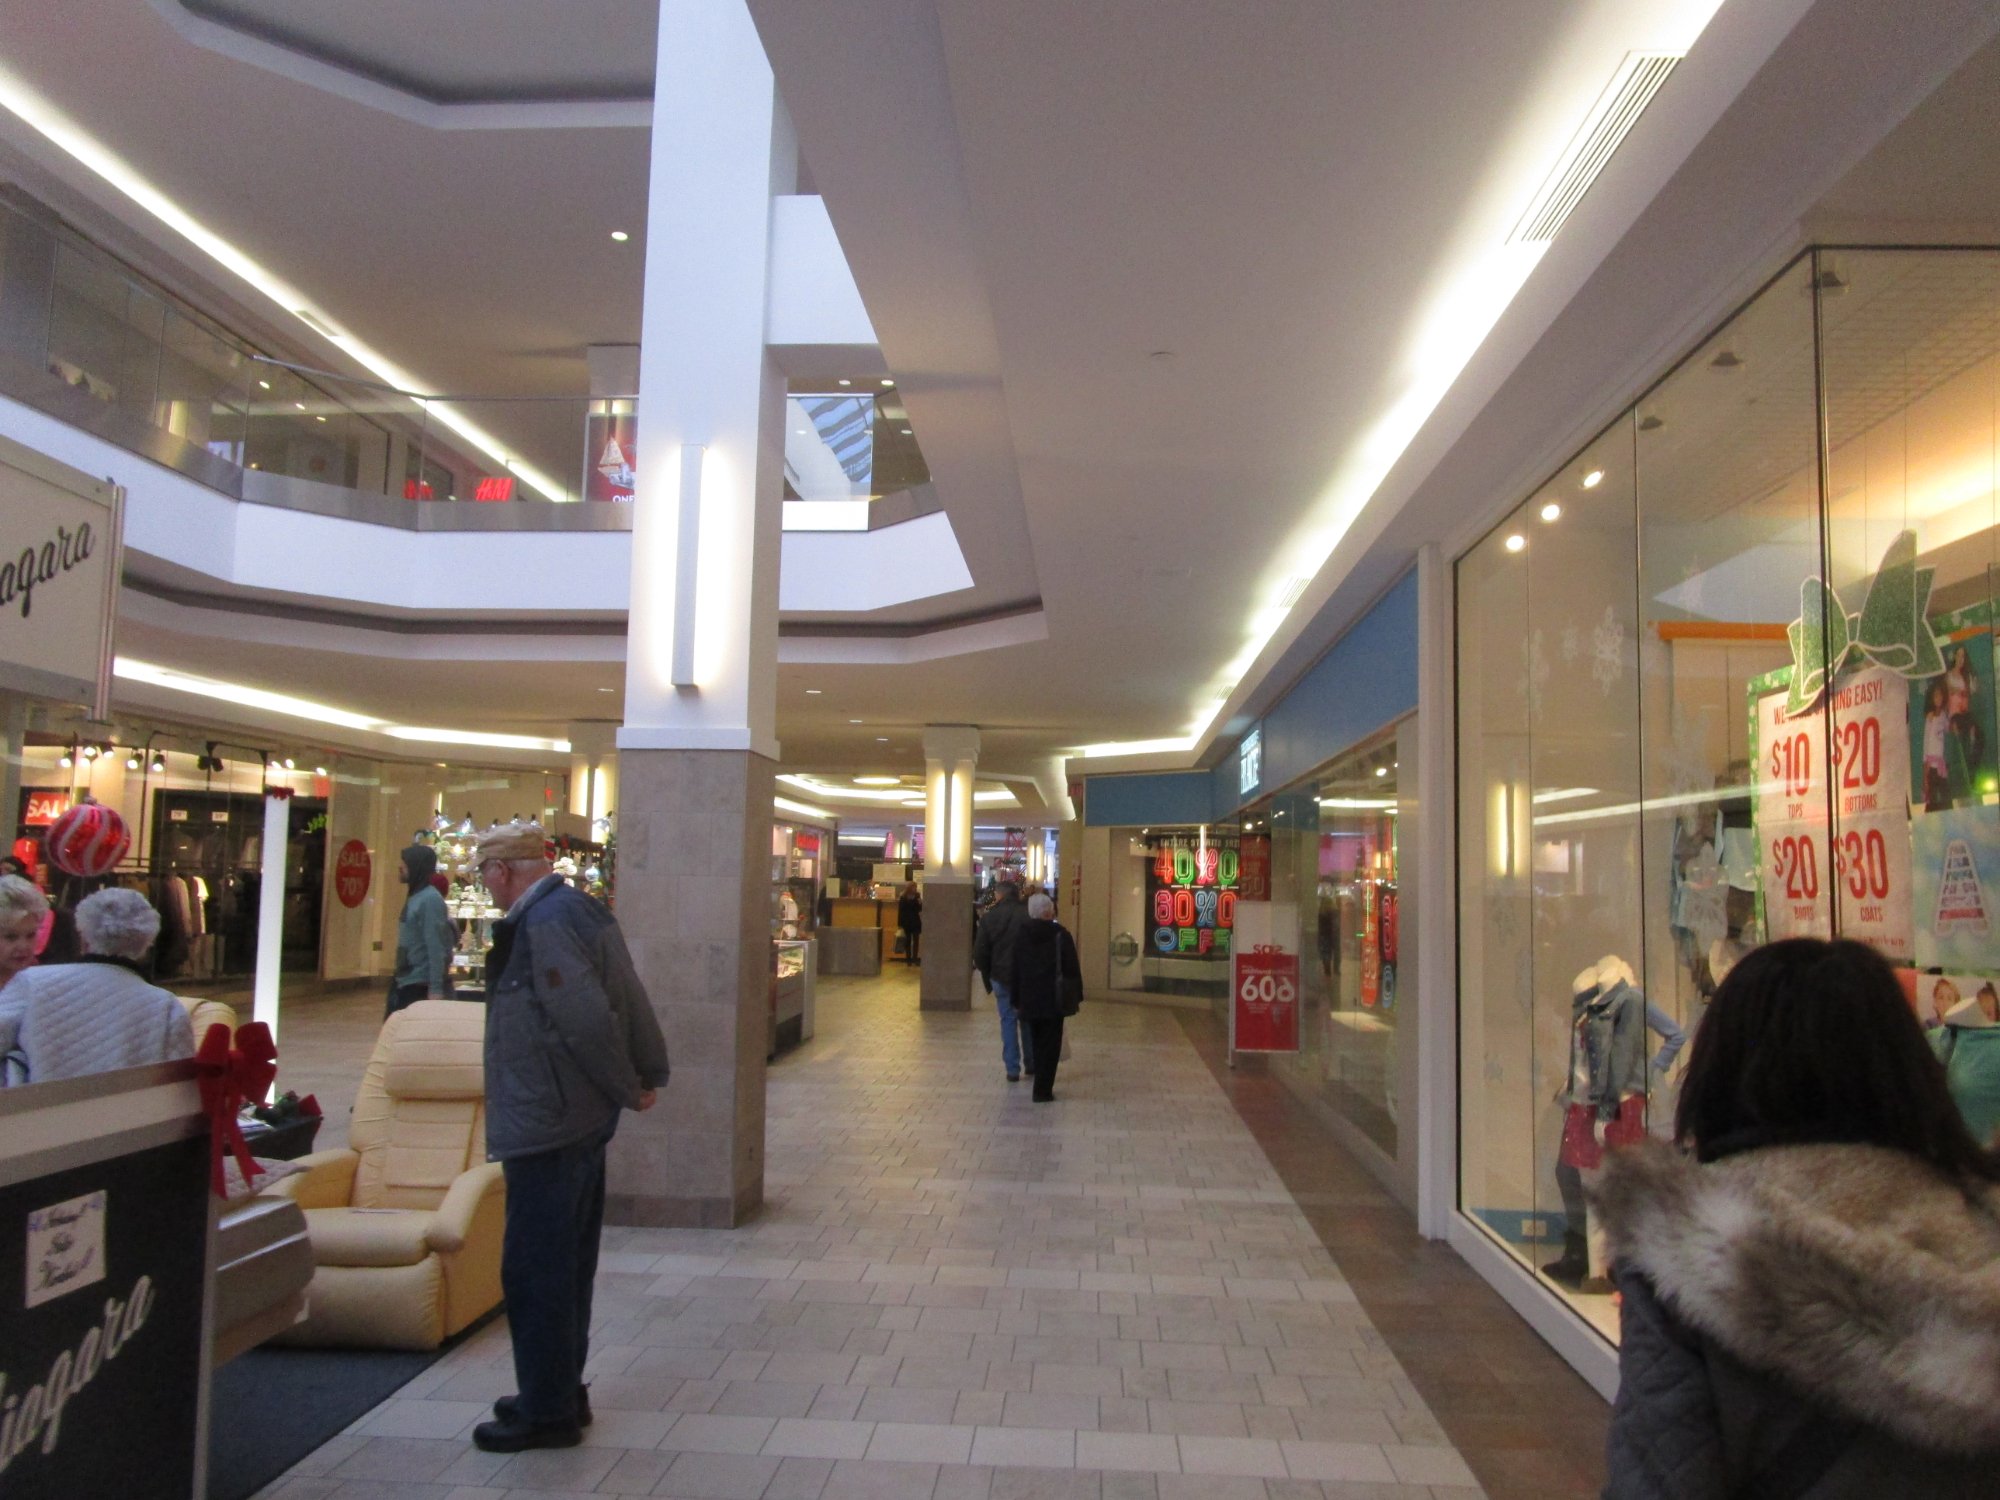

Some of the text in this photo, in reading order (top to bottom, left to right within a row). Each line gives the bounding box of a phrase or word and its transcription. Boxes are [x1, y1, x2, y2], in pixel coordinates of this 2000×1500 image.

[1855, 679, 1883, 706] EASY!
[1772, 716, 1880, 797] $10 $20
[1788, 793, 1878, 818] TOPS BOTTOMS
[1772, 835, 1818, 899] $20
[1833, 828, 1889, 899] $30
[1860, 906, 1883, 922] COATS
[0, 1275, 155, 1475] iagara
